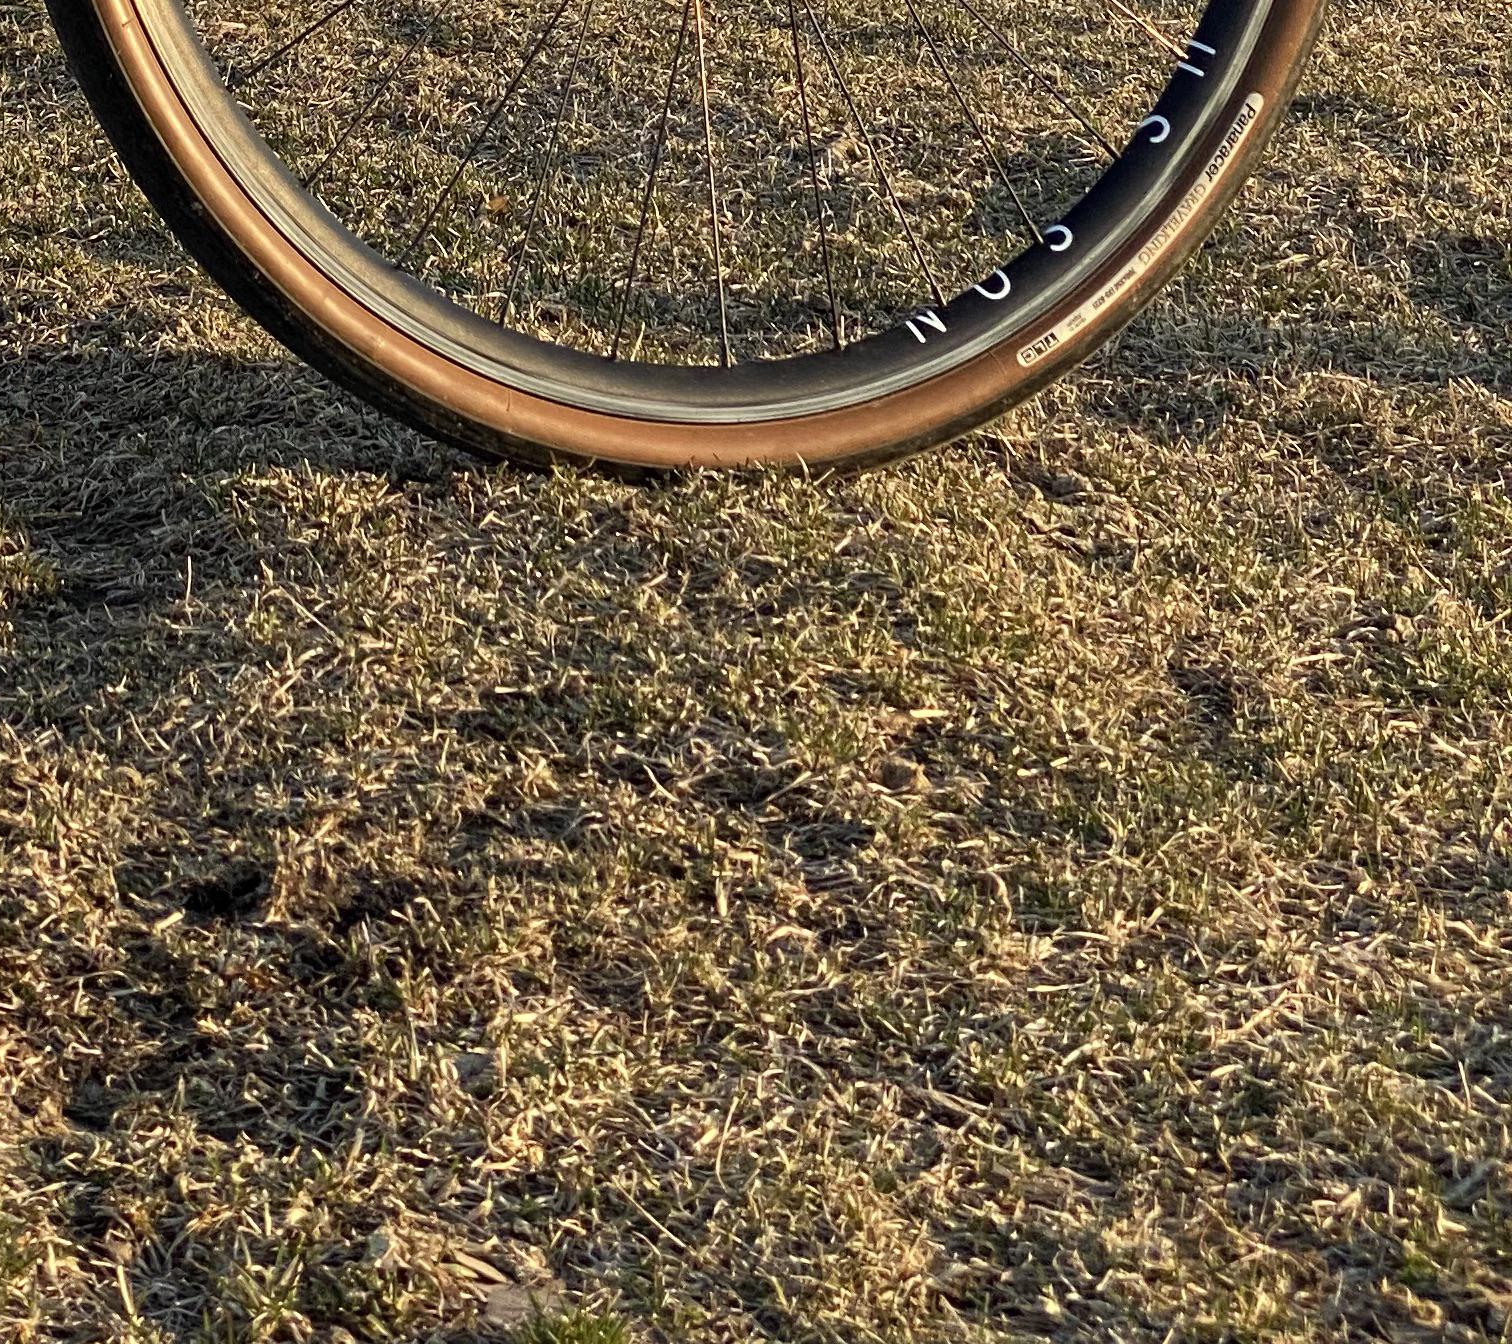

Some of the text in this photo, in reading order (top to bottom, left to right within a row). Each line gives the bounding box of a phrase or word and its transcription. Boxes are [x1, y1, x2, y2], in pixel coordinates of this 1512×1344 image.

[1205, 103, 1256, 182] Panaracer
[1139, 183, 1206, 265] GRAVELKING
[1020, 332, 1059, 363] TLC
